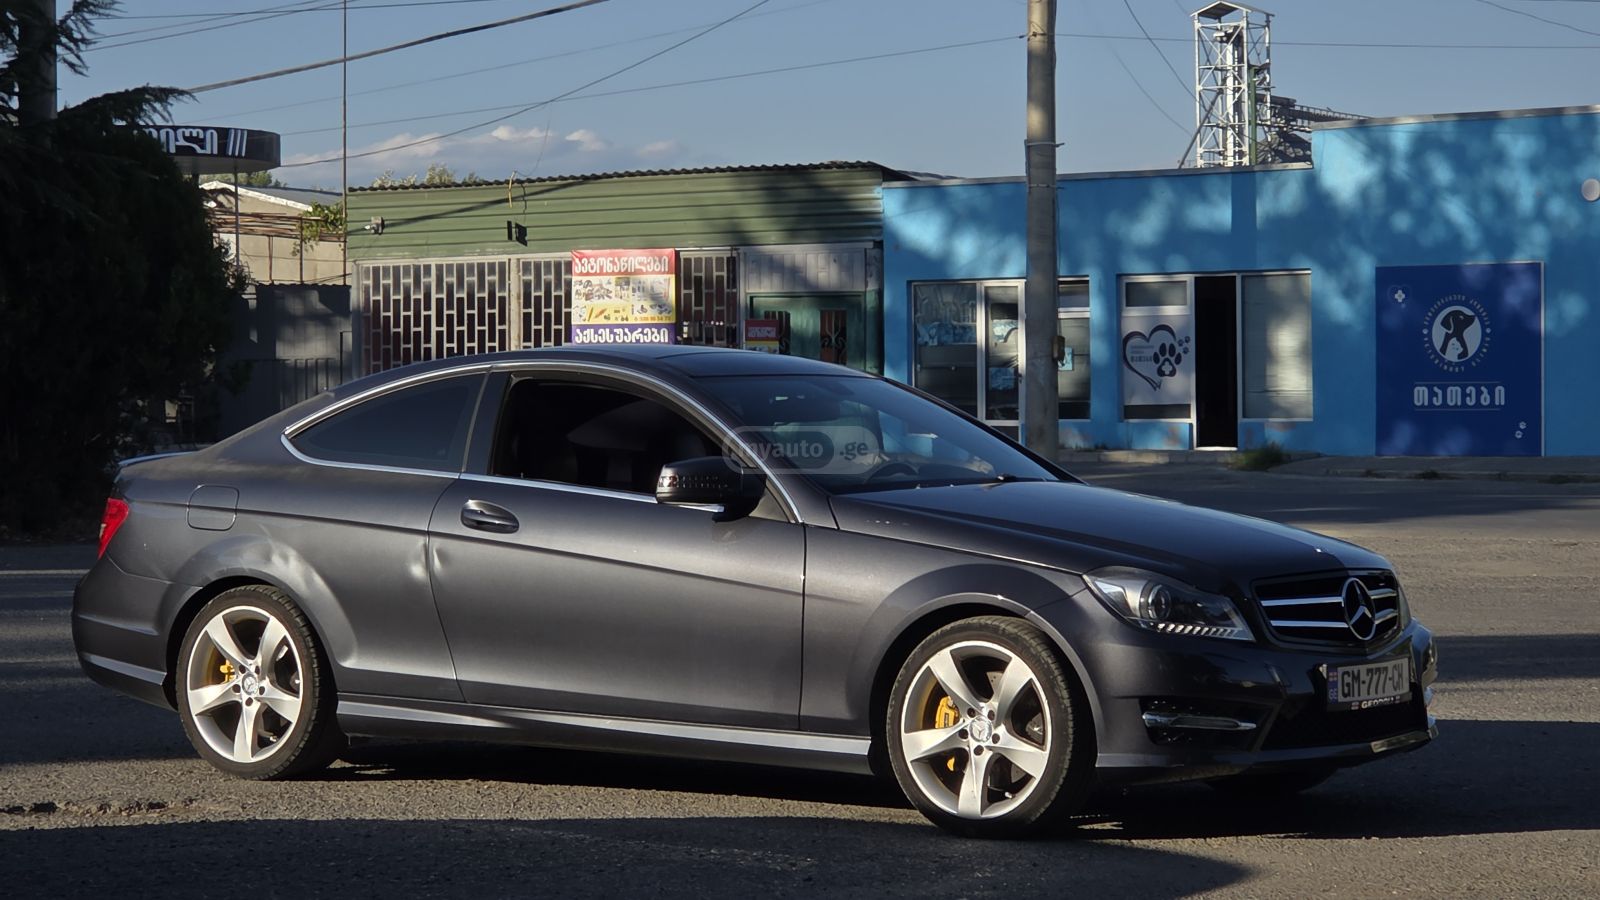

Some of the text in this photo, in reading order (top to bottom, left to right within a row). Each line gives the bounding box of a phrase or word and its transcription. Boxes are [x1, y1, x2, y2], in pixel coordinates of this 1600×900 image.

[575, 256, 668, 273] ავტონაწილები
[575, 328, 668, 343] აქსესუარები
[1413, 386, 1505, 406] თათები
